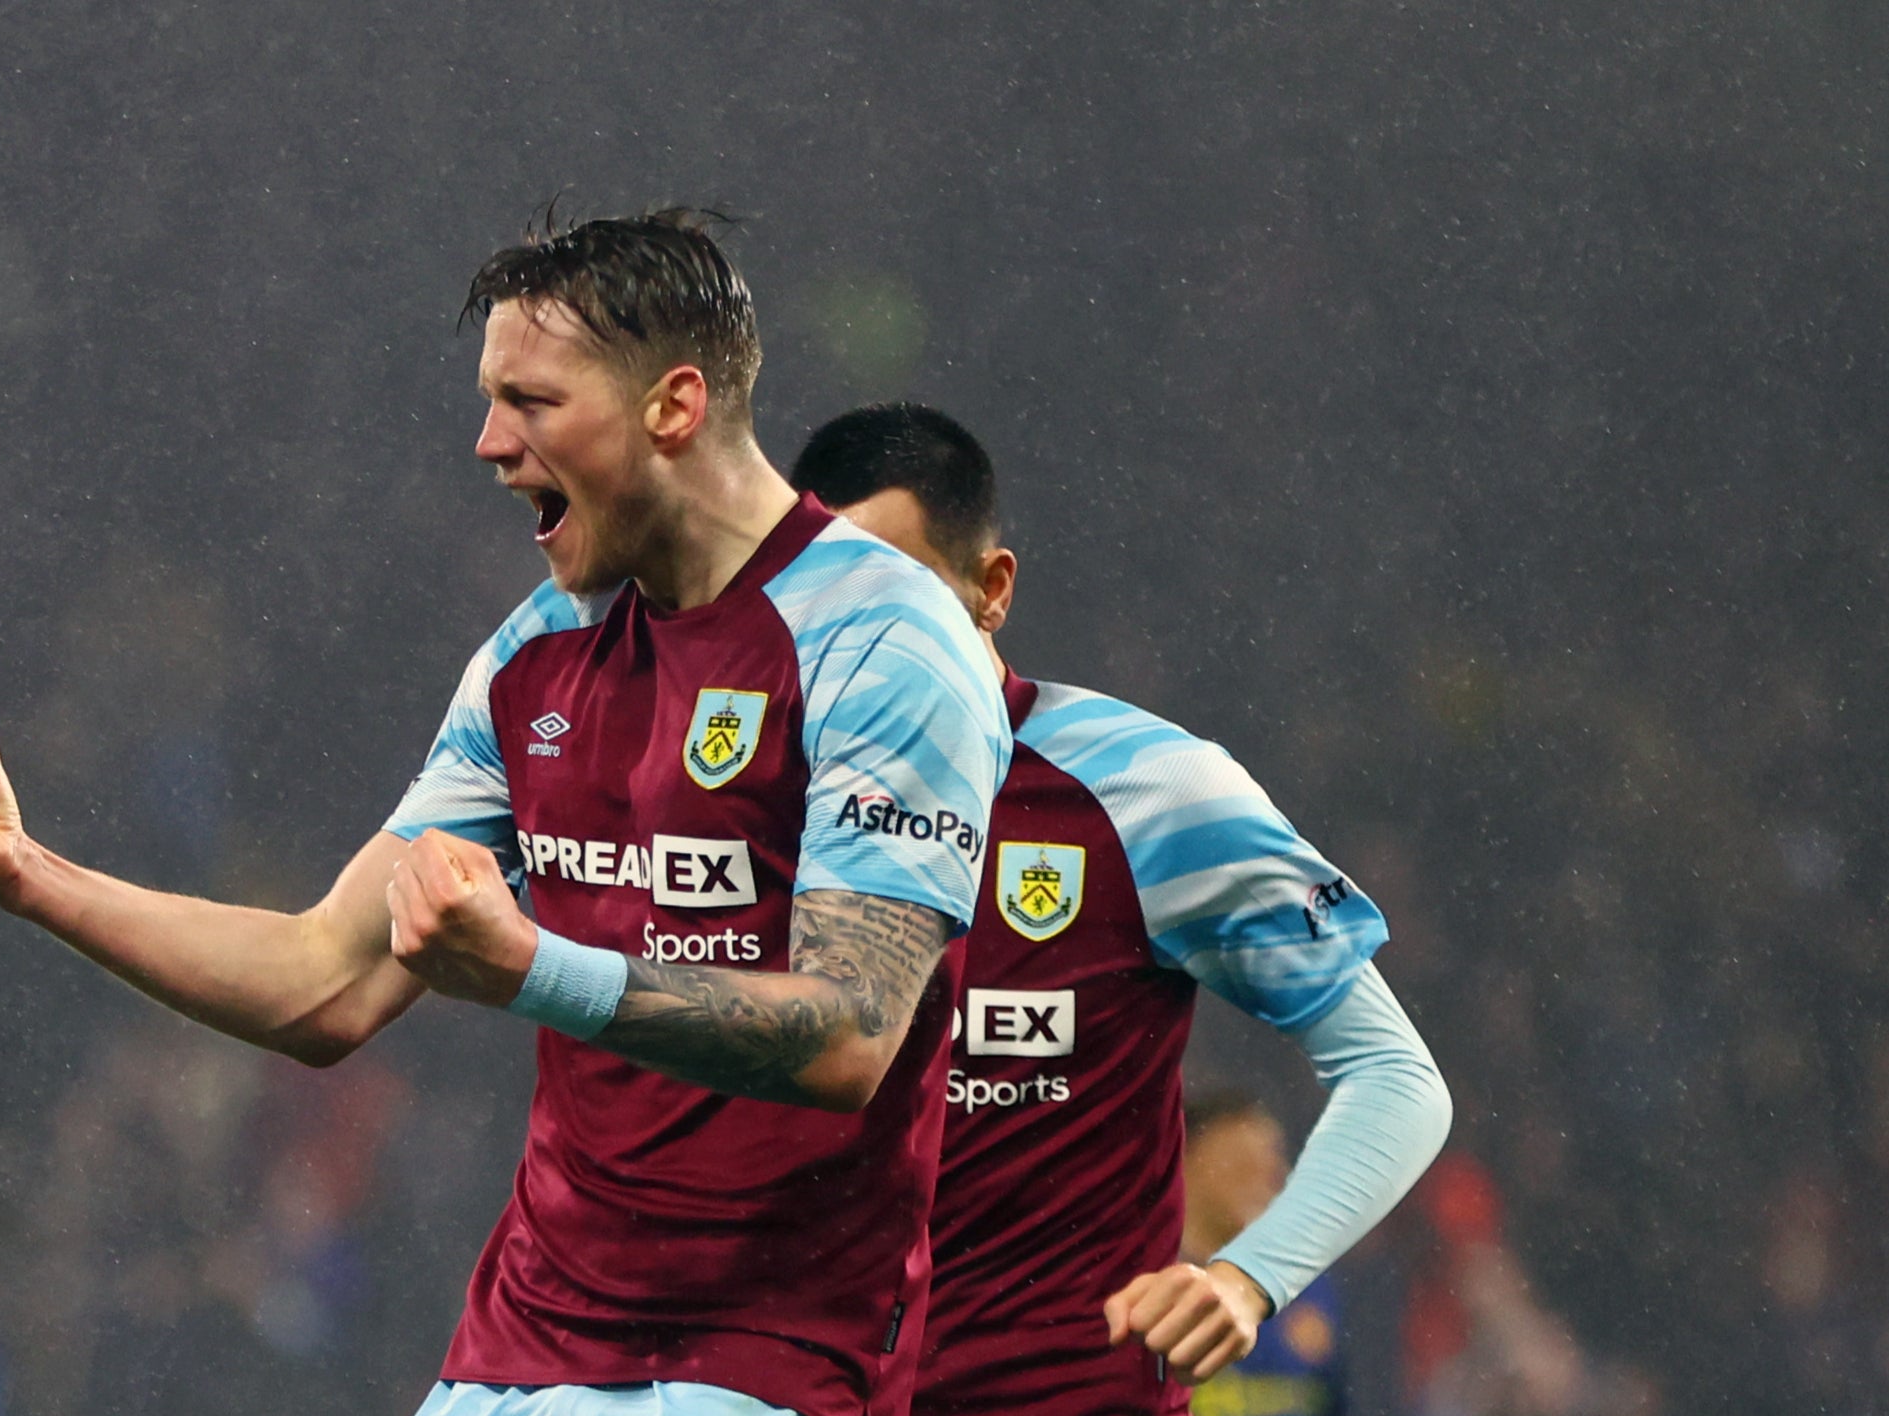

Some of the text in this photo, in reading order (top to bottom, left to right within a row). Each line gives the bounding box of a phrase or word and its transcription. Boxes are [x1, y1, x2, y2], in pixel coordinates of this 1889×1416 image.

[527, 741, 561, 758] umbro
[834, 793, 985, 864] AstroPay
[642, 921, 762, 966] Sports
[945, 1068, 1071, 1115] Sports
